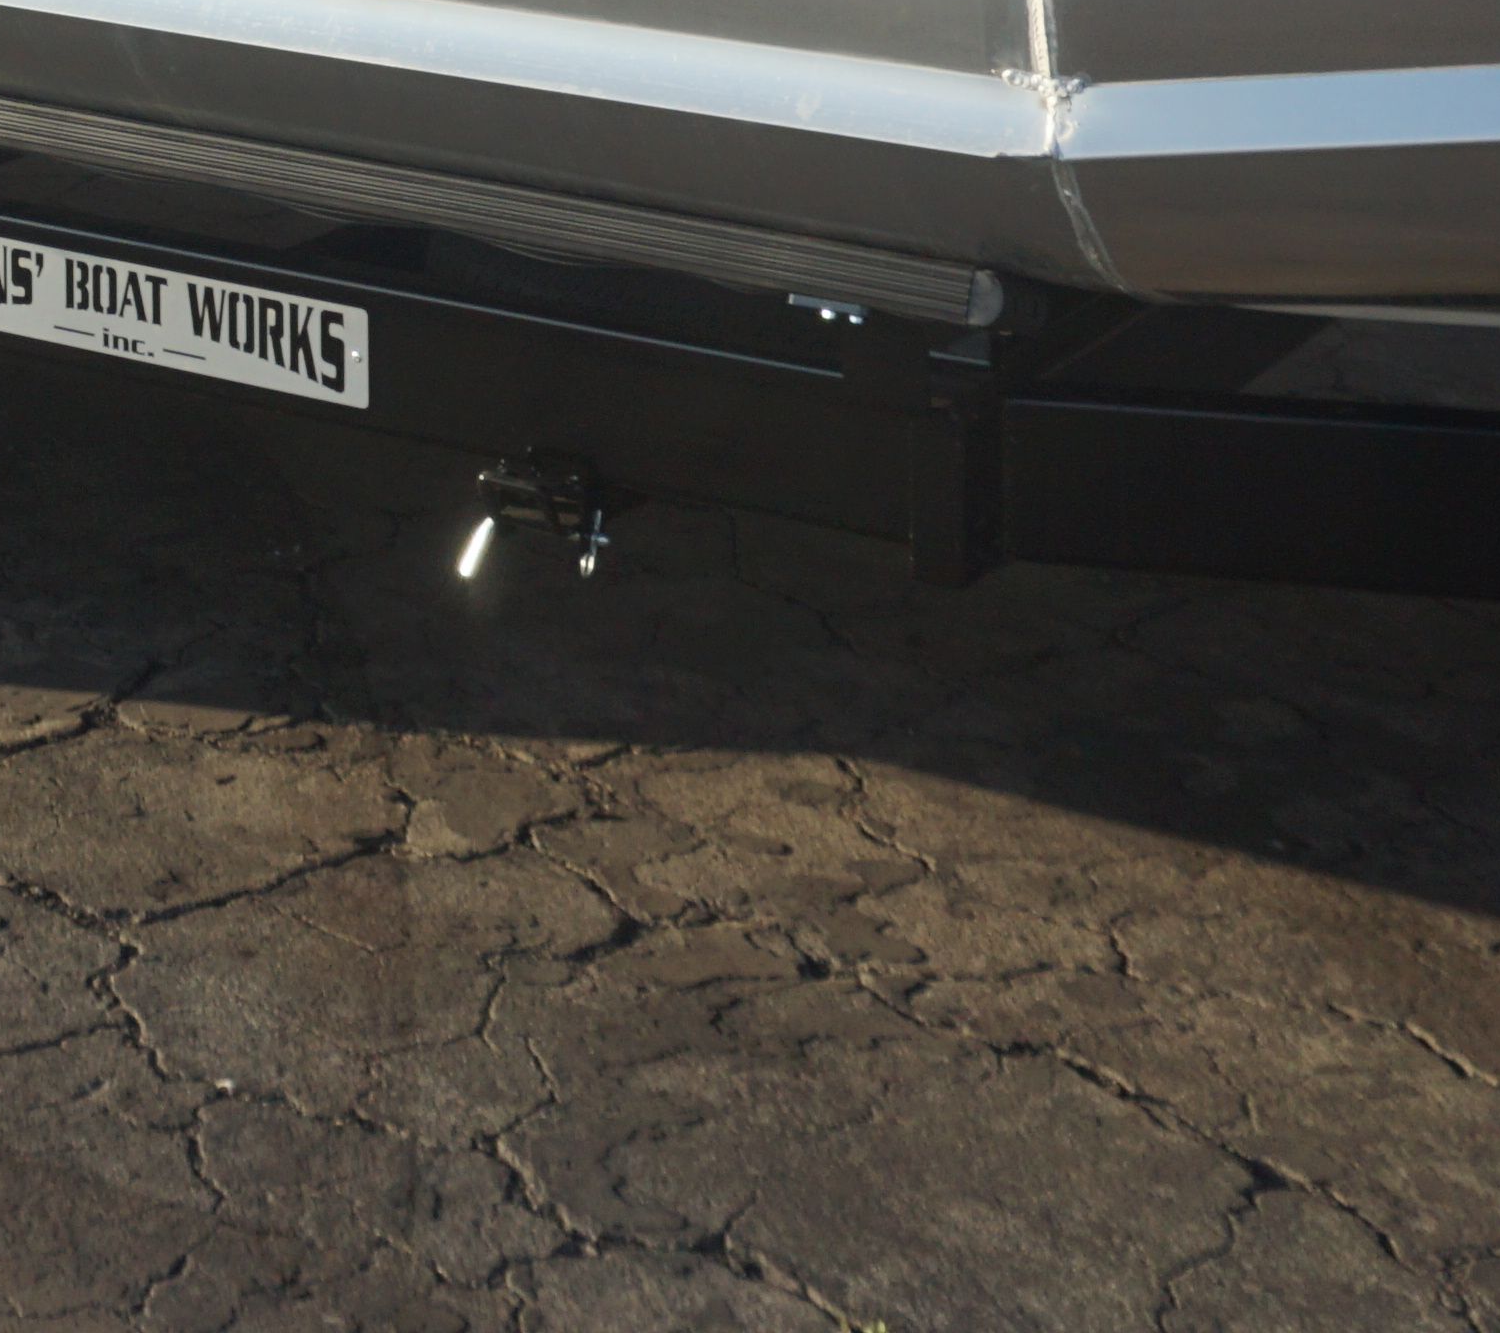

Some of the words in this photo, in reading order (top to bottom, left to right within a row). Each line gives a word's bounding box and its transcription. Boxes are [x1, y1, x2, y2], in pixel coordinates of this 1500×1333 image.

[64, 257, 168, 326] BOAT
[188, 282, 346, 395] WORKS
[101, 327, 155, 358] inc.
